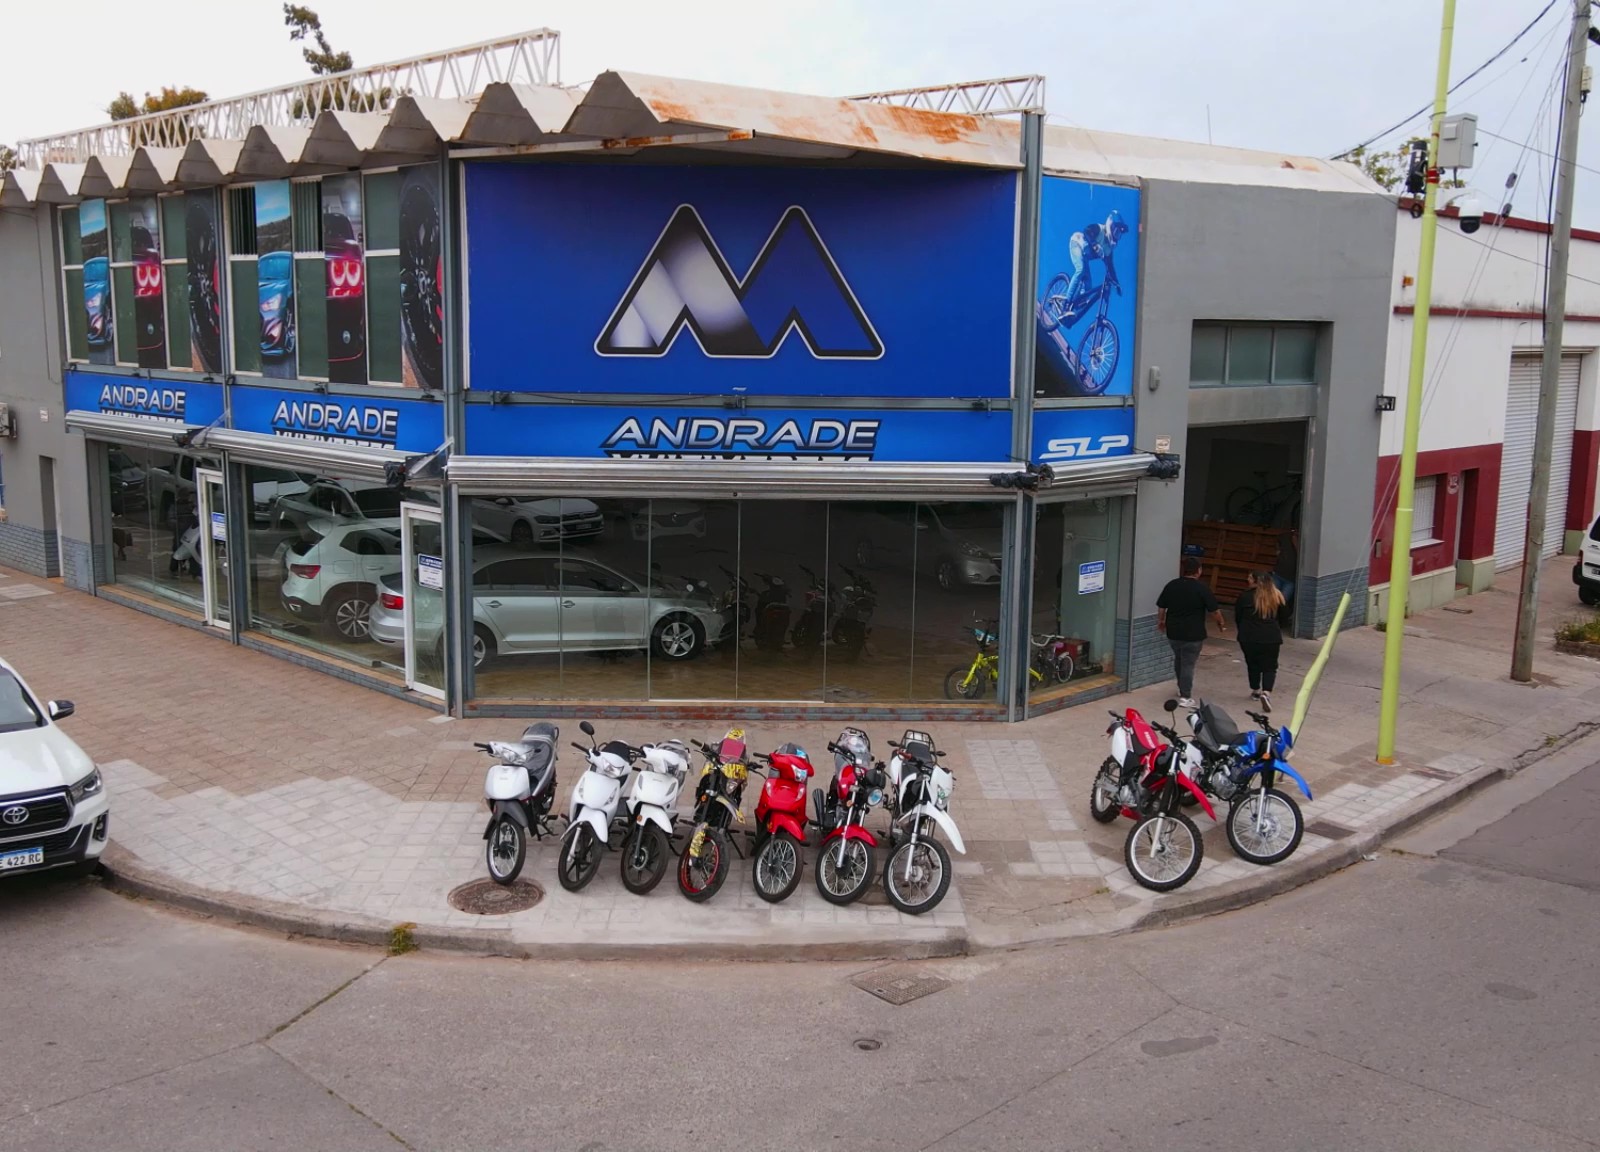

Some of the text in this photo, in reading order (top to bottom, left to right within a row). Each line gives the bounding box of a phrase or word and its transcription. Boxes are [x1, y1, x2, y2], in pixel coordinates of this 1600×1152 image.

[99, 384, 186, 413] ANDRADE
[272, 400, 398, 436] ANDRADE
[601, 417, 880, 449] ANDRADE
[1039, 435, 1129, 459] SLP
[7, 856, 26, 866] 422
